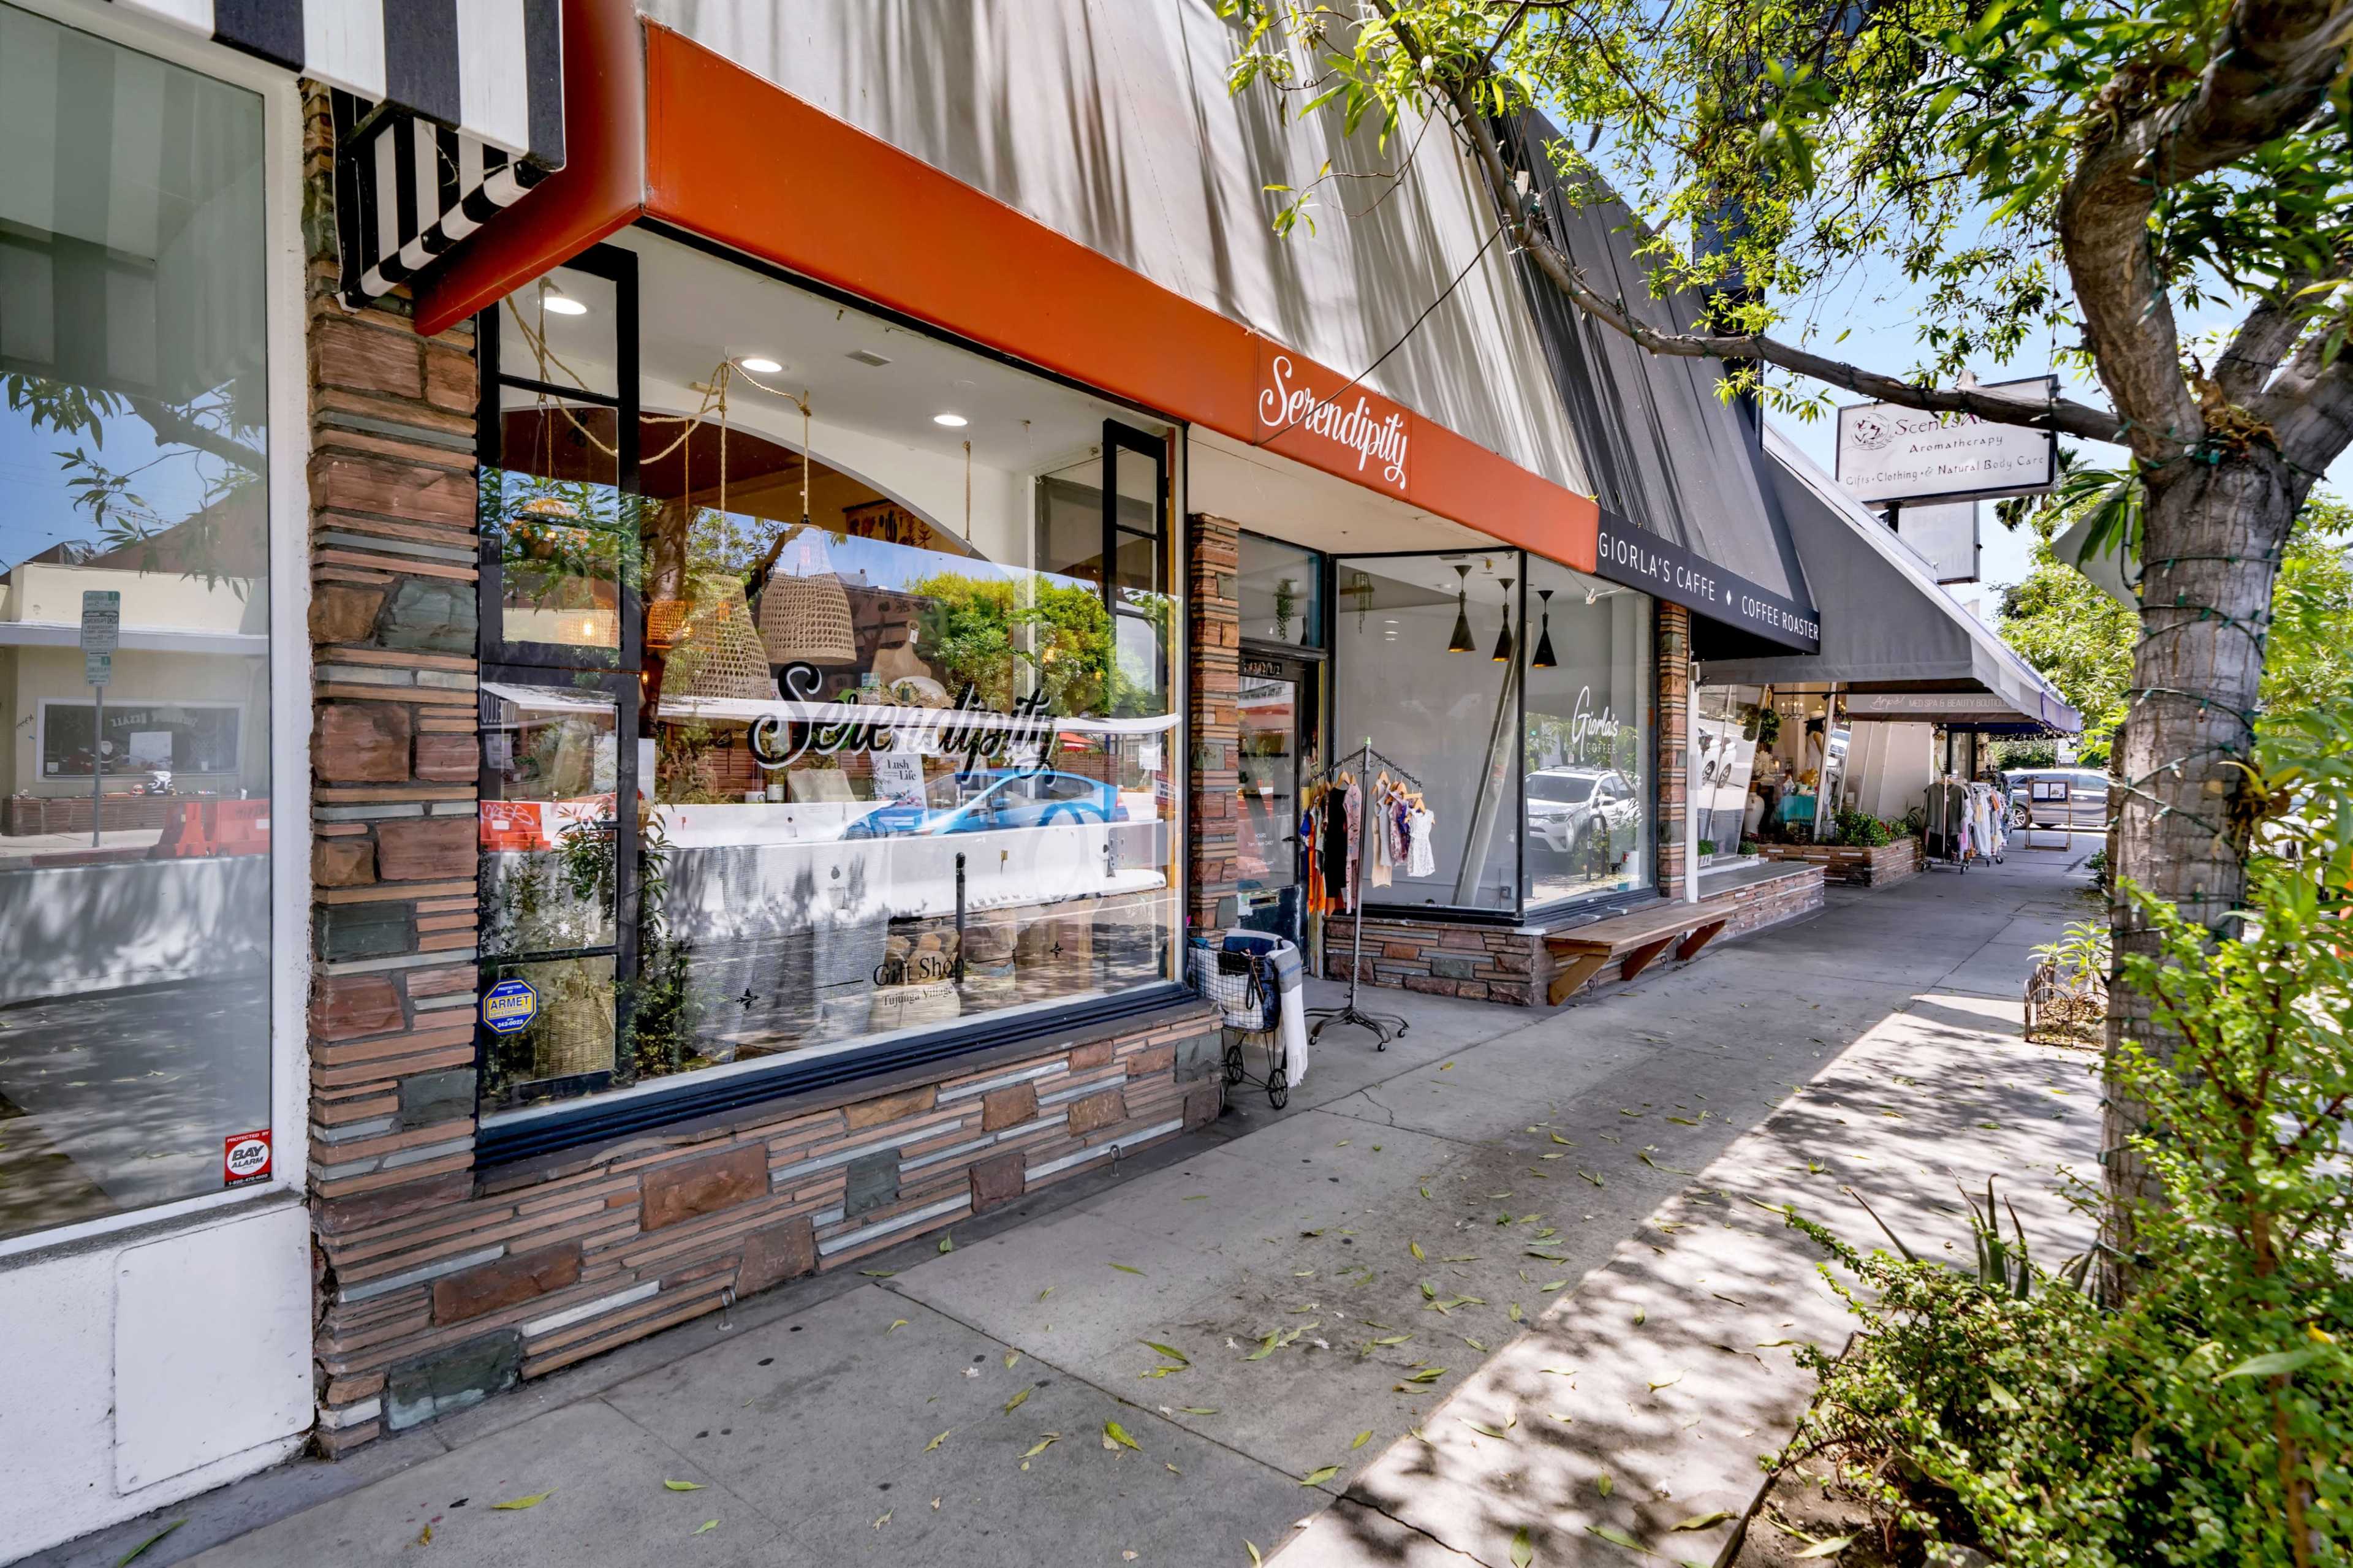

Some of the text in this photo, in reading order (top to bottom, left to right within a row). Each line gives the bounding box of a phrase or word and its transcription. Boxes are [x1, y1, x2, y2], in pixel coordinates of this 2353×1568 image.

[1259, 355, 1407, 490] Serendipity
[1909, 436, 2003, 453] Aromatherapy
[1846, 475, 1870, 488] Gifts
[1877, 470, 1918, 483] Clothing
[1938, 461, 1980, 475] Natural
[1984, 456, 2012, 471] Body
[2017, 455, 2044, 467] Care
[1598, 532, 1715, 601] GIORLA'S CAFFE
[1741, 596, 1819, 641] COFFEE ROASTER
[1909, 699, 1923, 708] MED
[1924, 699, 1938, 708] SPA
[1947, 699, 1976, 707] BEAUTY
[747, 661, 1058, 787] Serendipity
[1572, 686, 1620, 762] Giorla's
[1586, 742, 1617, 754] COFFEE
[887, 759, 909, 770] Lush
[899, 770, 917, 781] Life
[873, 956, 965, 986] Gift Shop
[490, 996, 529, 1010] ARMET
[882, 985, 954, 1007] Tujunga Village
[227, 1133, 260, 1143] PROTECTED
[232, 1145, 265, 1161] BAY
[231, 1157, 263, 1168] ALARM
